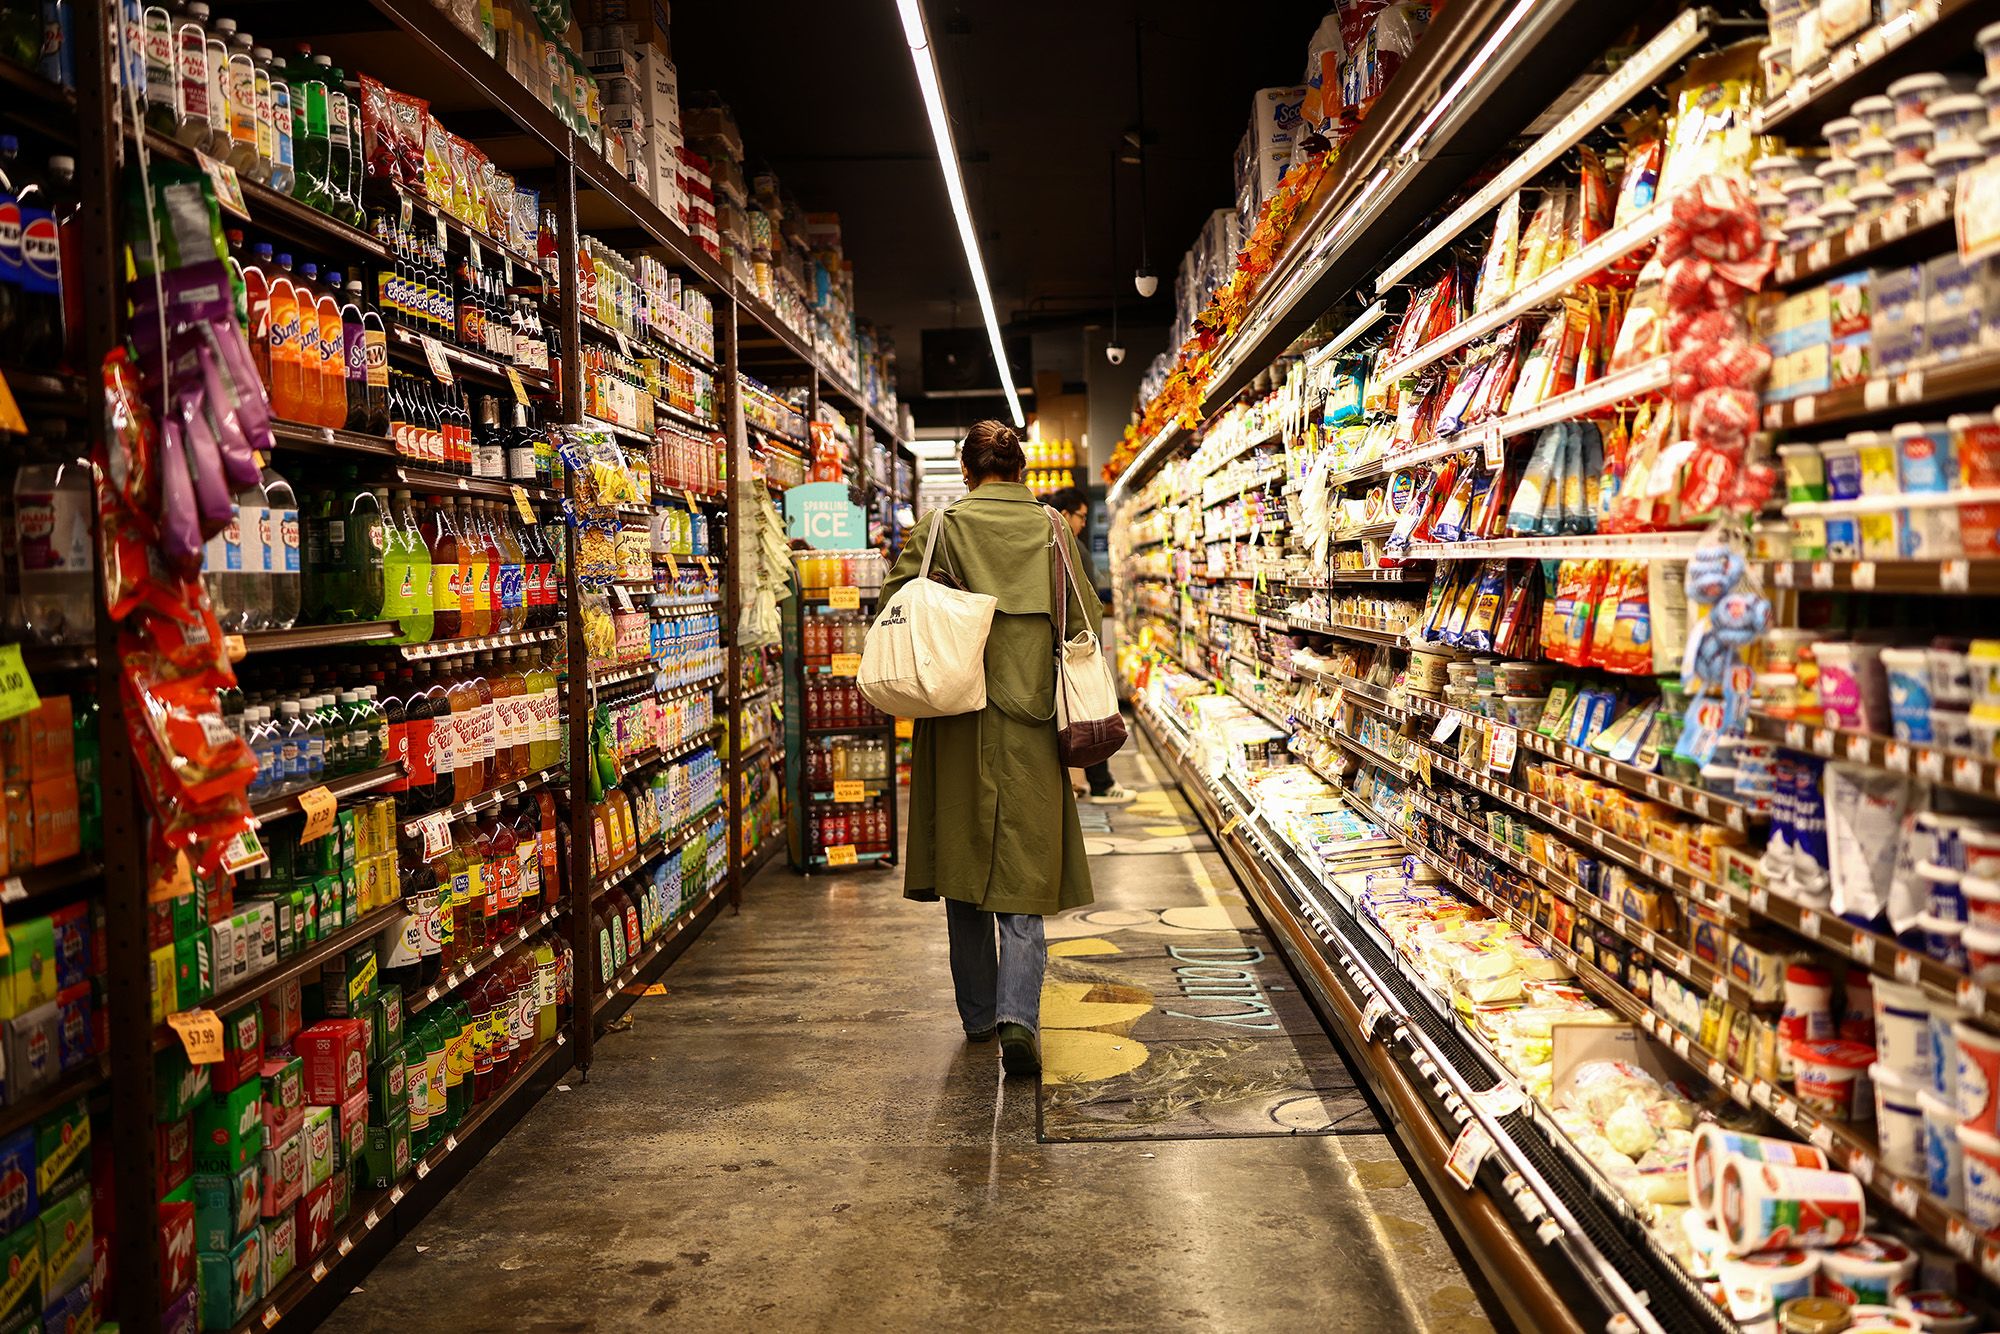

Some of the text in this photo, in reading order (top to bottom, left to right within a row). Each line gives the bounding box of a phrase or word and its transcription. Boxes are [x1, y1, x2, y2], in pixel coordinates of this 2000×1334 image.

[803, 501, 849, 511] SPARKLING
[803, 511, 849, 538] ICE
[881, 616, 908, 628] STANLEY
[1161, 945, 1285, 1030] Dairy
[188, 1029, 215, 1047] $7.99
